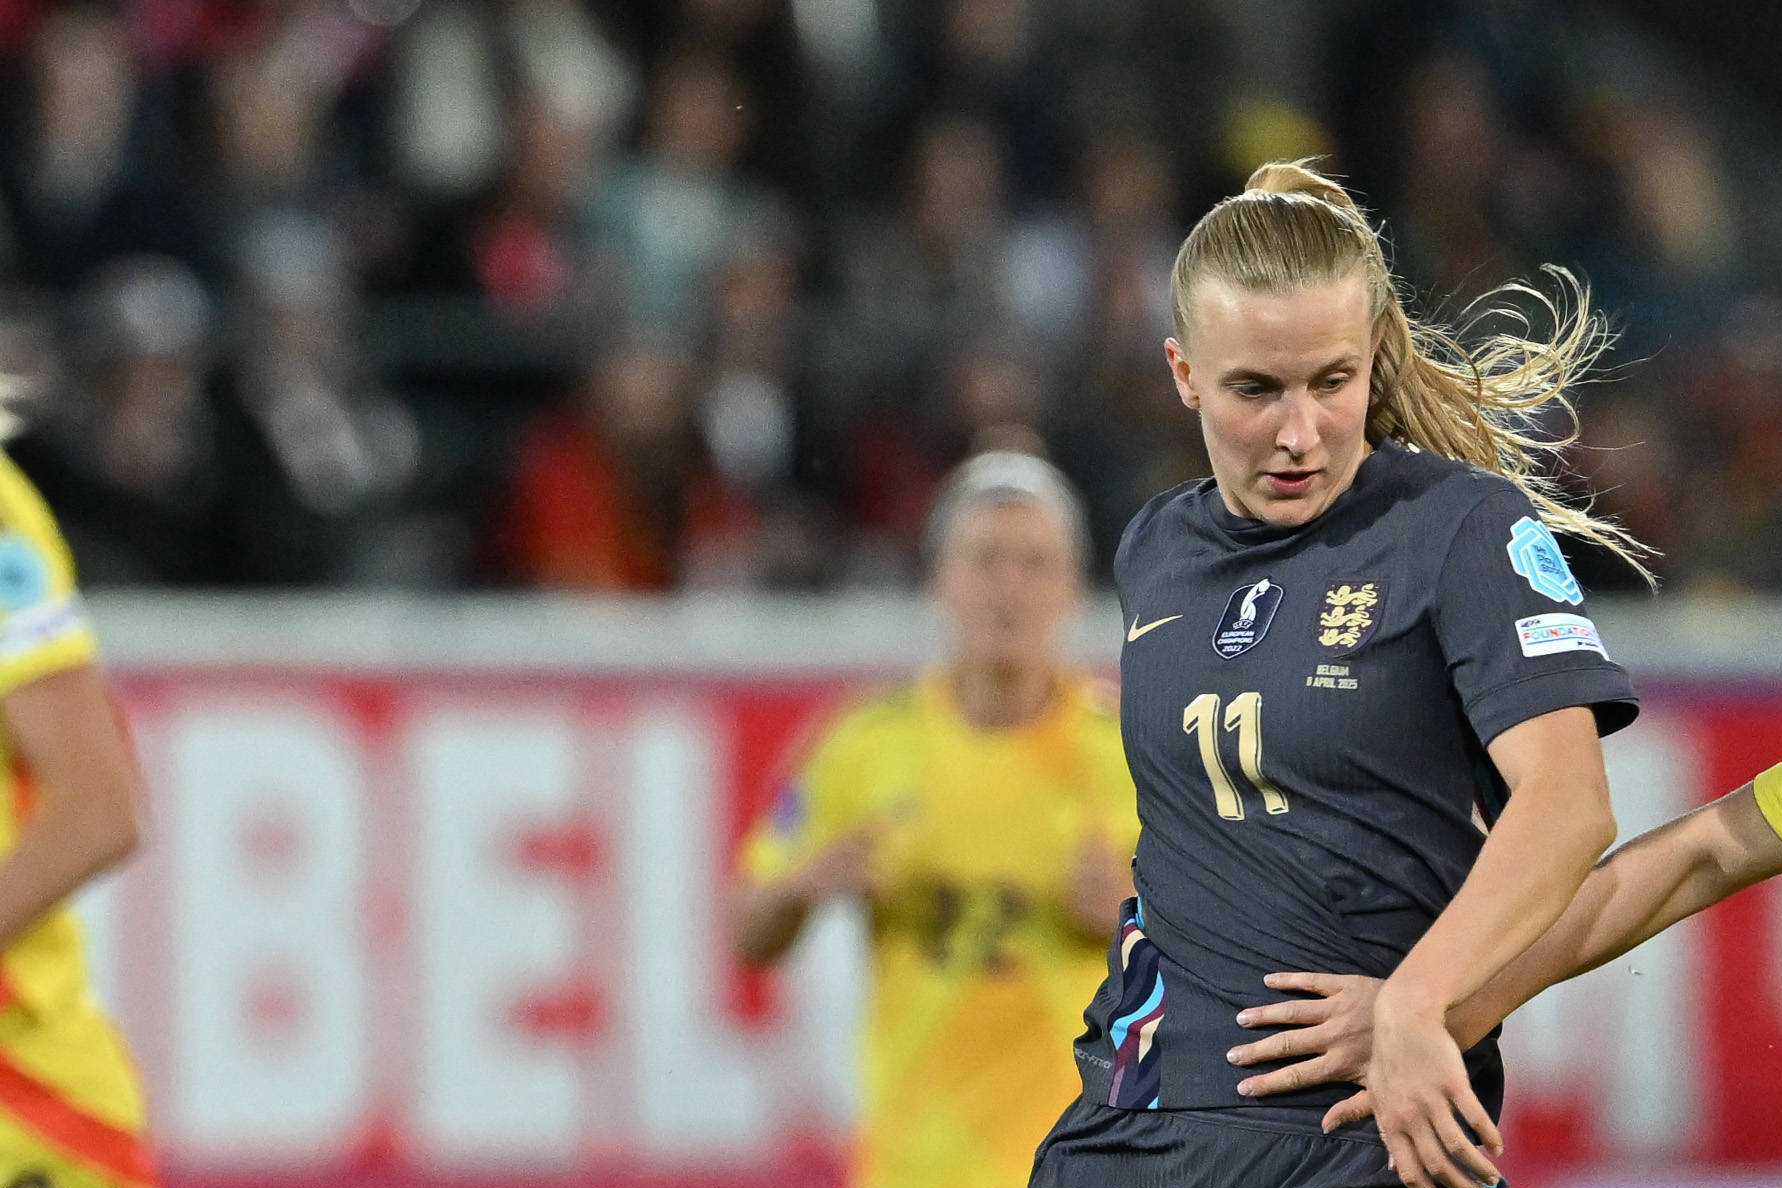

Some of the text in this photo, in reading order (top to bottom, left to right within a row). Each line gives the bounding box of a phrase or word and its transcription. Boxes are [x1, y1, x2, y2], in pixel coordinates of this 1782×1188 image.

[1316, 664, 1350, 676] BELGIUM
[1312, 677, 1336, 688] APRIL
[1337, 678, 1359, 690] 2025
[1182, 692, 1289, 820] 11
